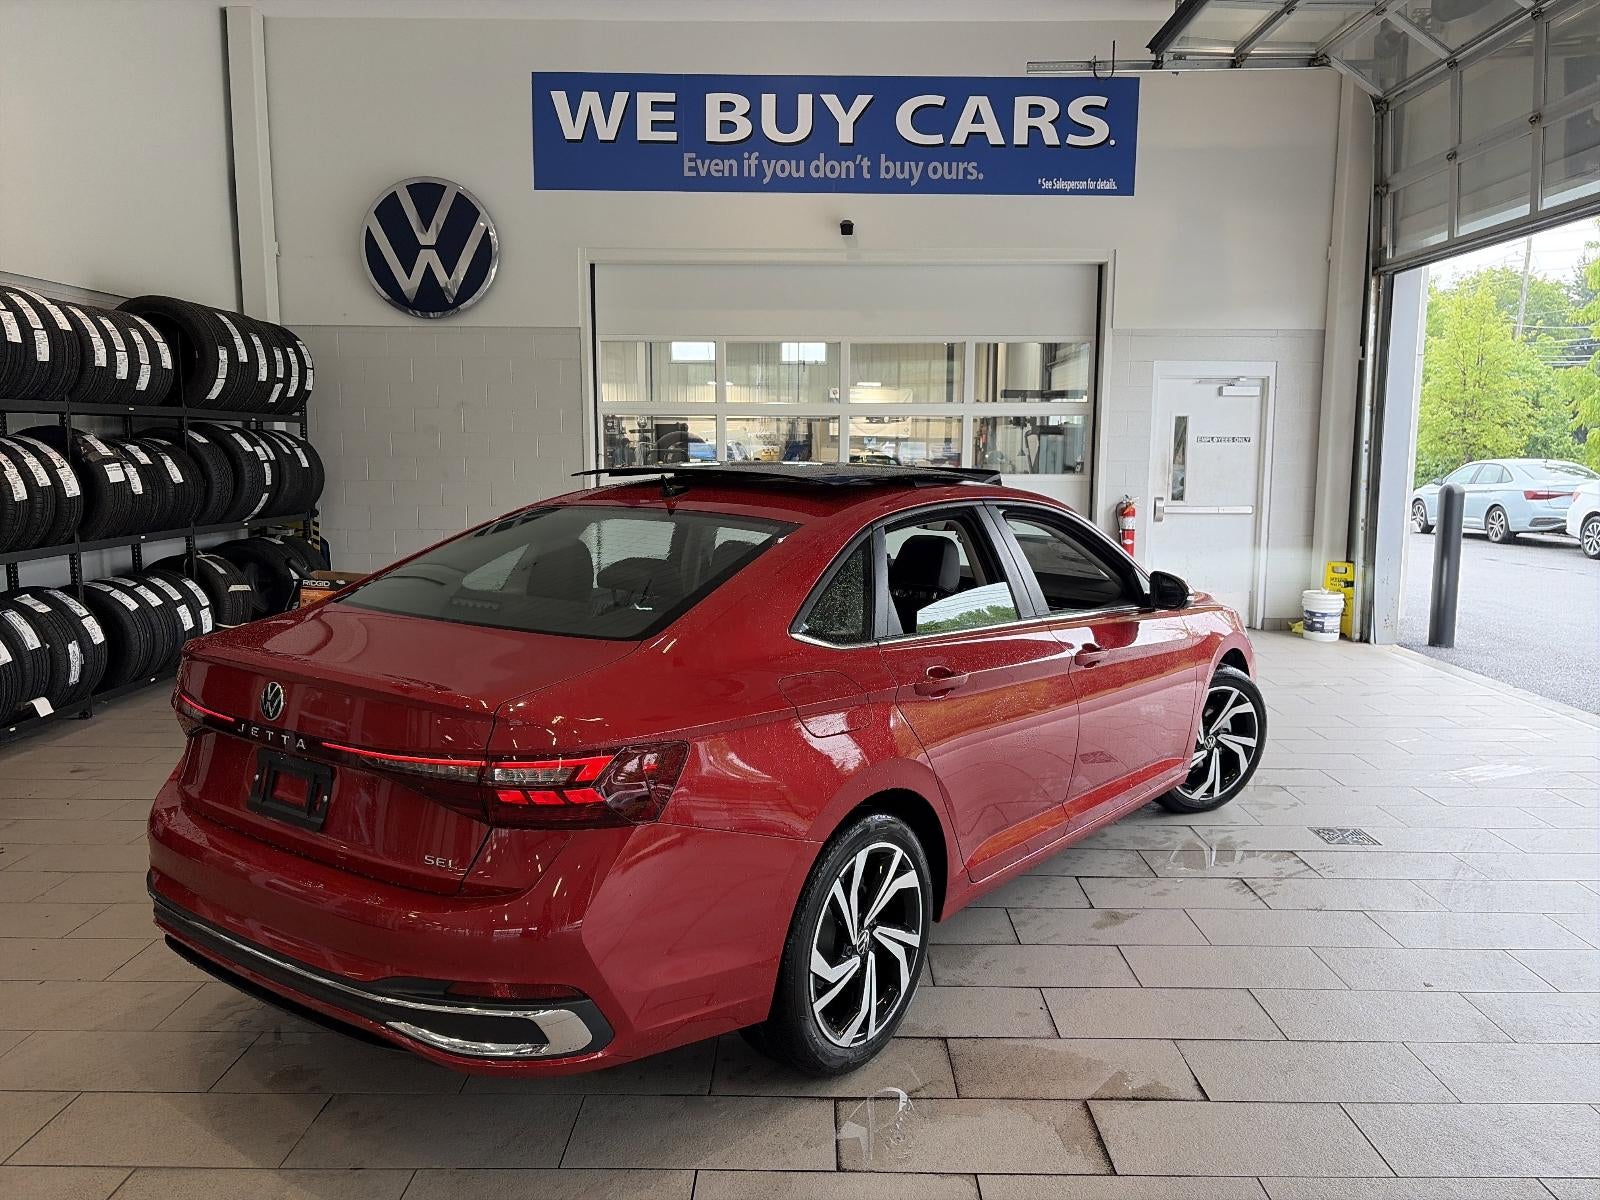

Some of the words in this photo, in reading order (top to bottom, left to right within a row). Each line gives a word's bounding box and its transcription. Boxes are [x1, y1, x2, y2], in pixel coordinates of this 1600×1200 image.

[550, 90, 678, 142] WE
[705, 93, 874, 145] BUY
[895, 94, 1116, 147] CARS.
[683, 152, 738, 177] Even
[743, 152, 759, 177] if
[762, 159, 805, 185] you
[809, 152, 871, 179] don't
[880, 153, 924, 187] buy
[928, 161, 984, 180] ours.
[1053, 178, 1086, 192] Salesperson
[1087, 178, 1096, 189] for
[237, 723, 306, 750] JETTA
[424, 855, 457, 869] SEL
